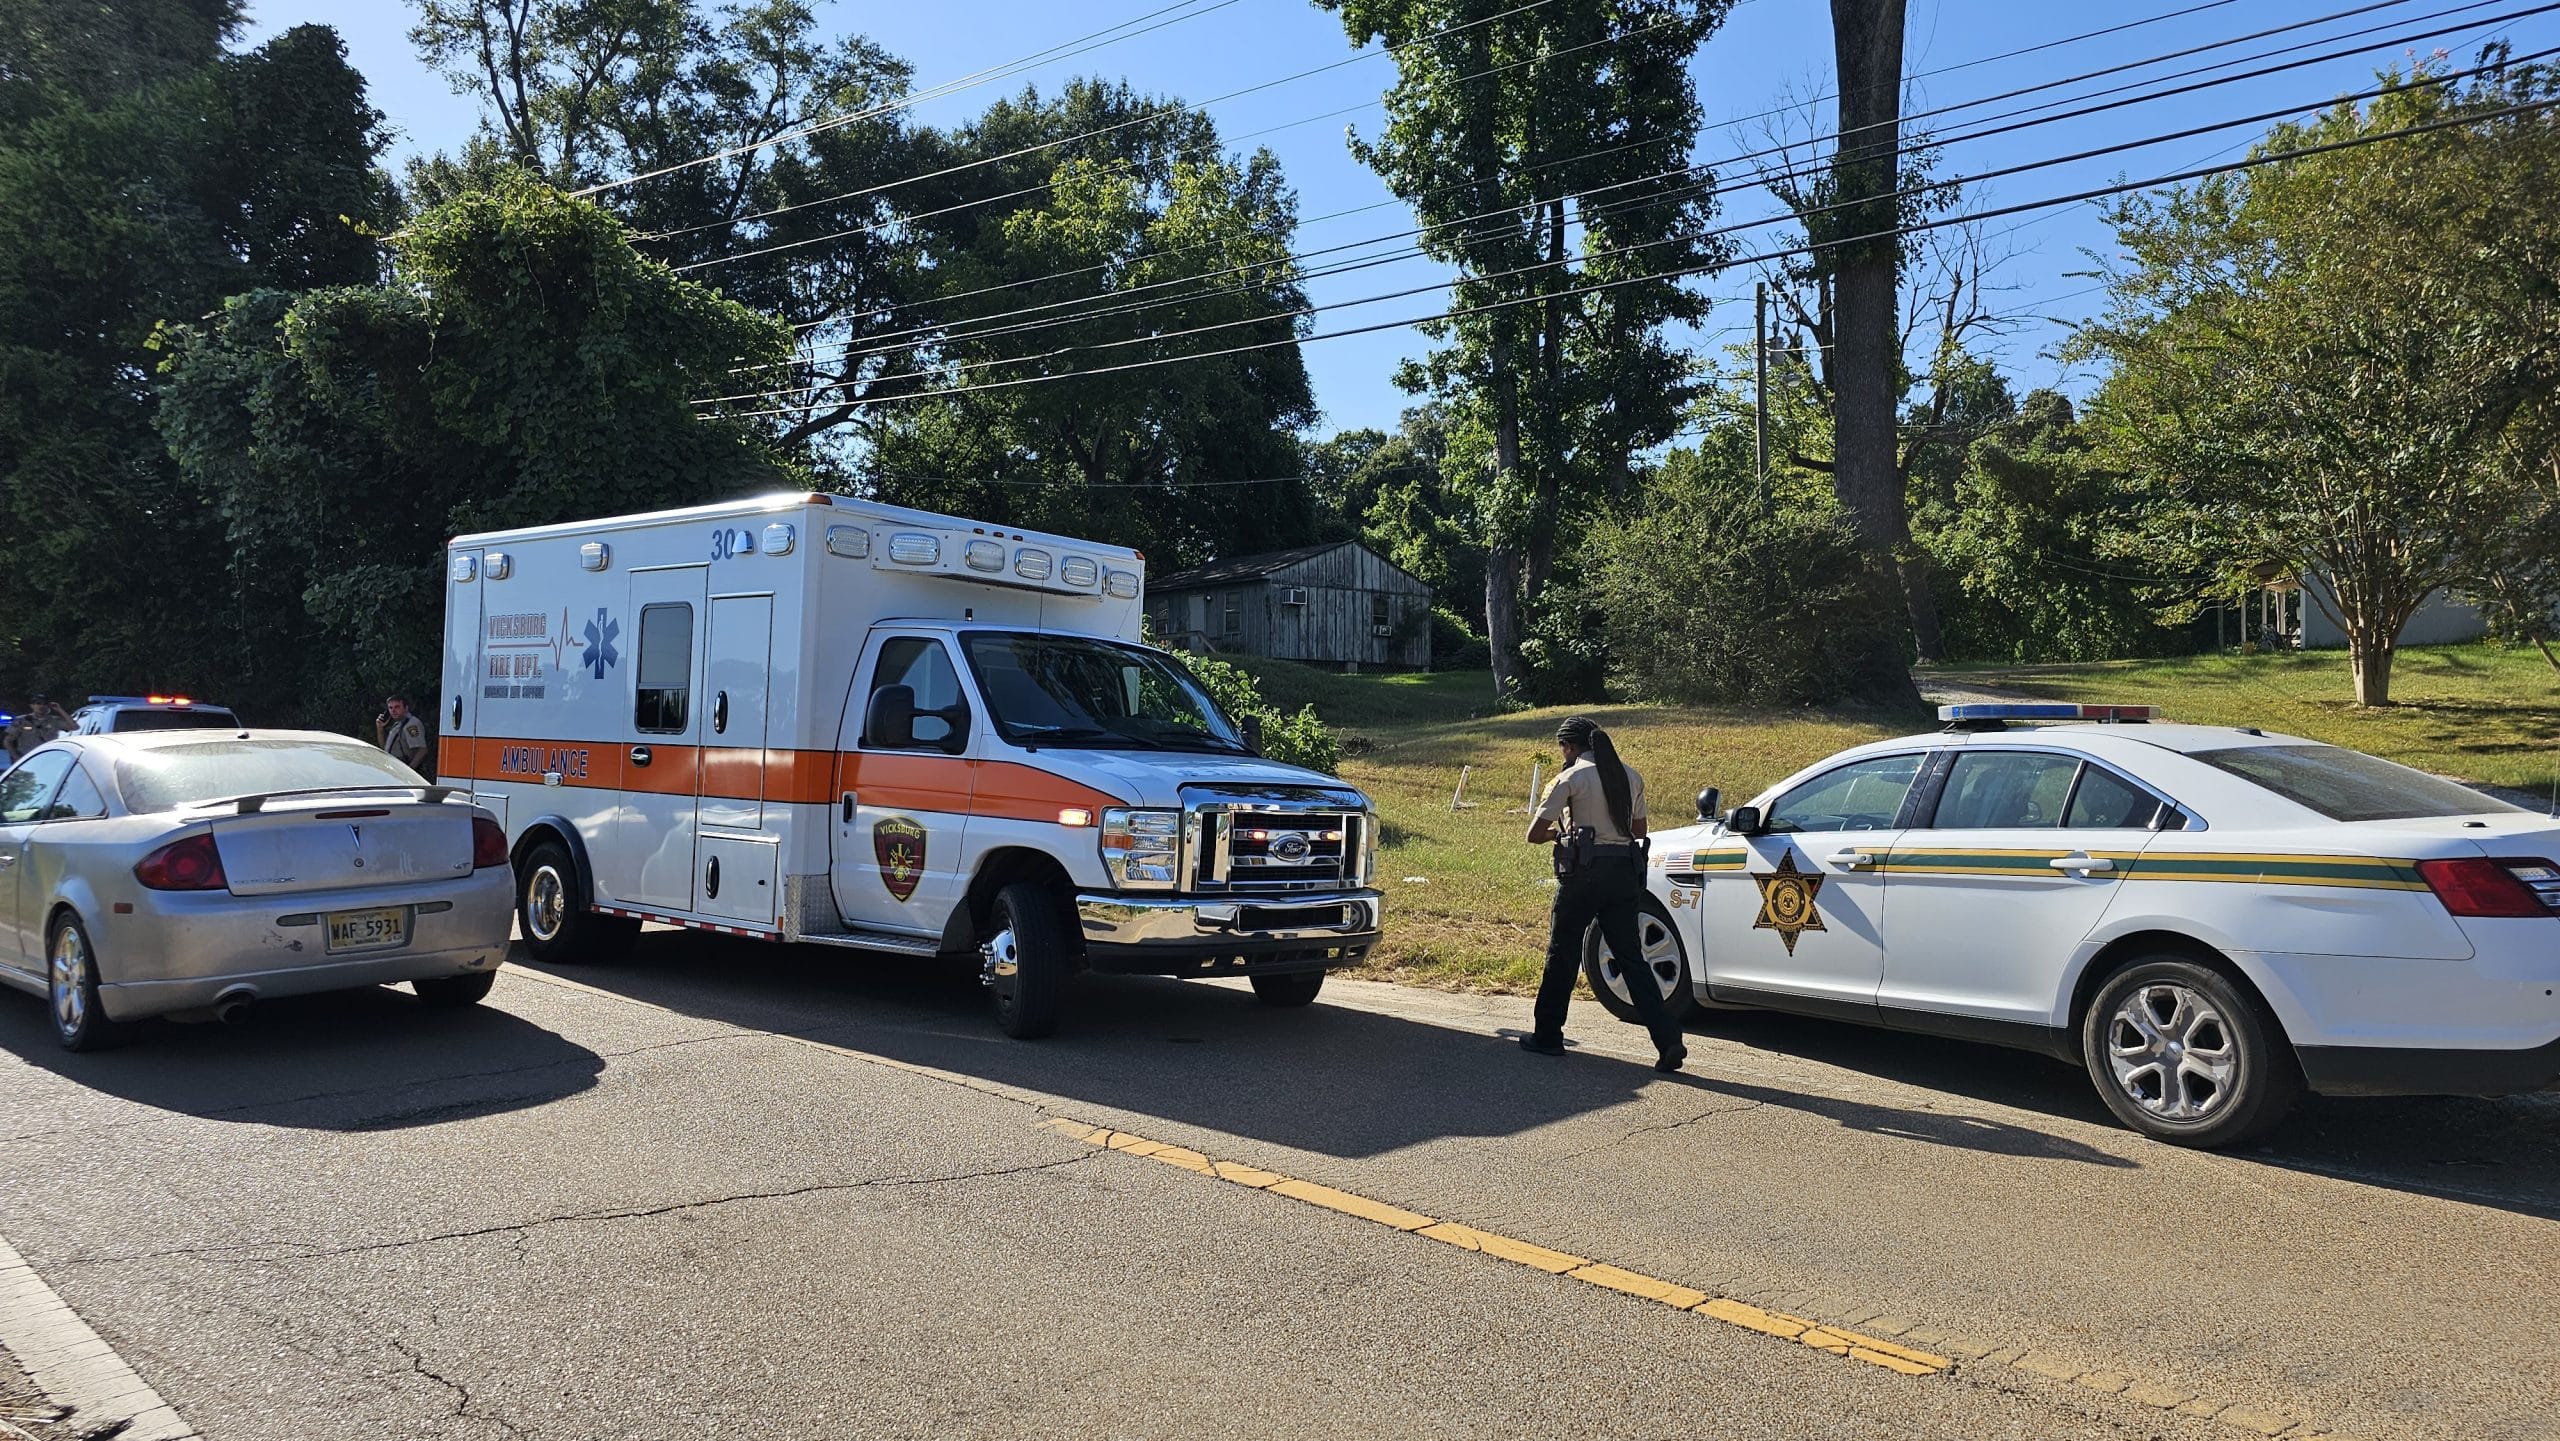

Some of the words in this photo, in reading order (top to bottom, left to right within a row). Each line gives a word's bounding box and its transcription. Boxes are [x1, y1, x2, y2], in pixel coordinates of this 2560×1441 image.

[711, 528, 736, 560] 30
[489, 612, 547, 640] VICKSBURG
[489, 654, 511, 678] FIRE
[514, 653, 542, 678] DEPT.
[500, 745, 589, 778] AMBULANCE
[881, 823, 920, 839] VICKSBURG
[1670, 889, 1701, 909] S-7
[366, 918, 401, 937] 5931
